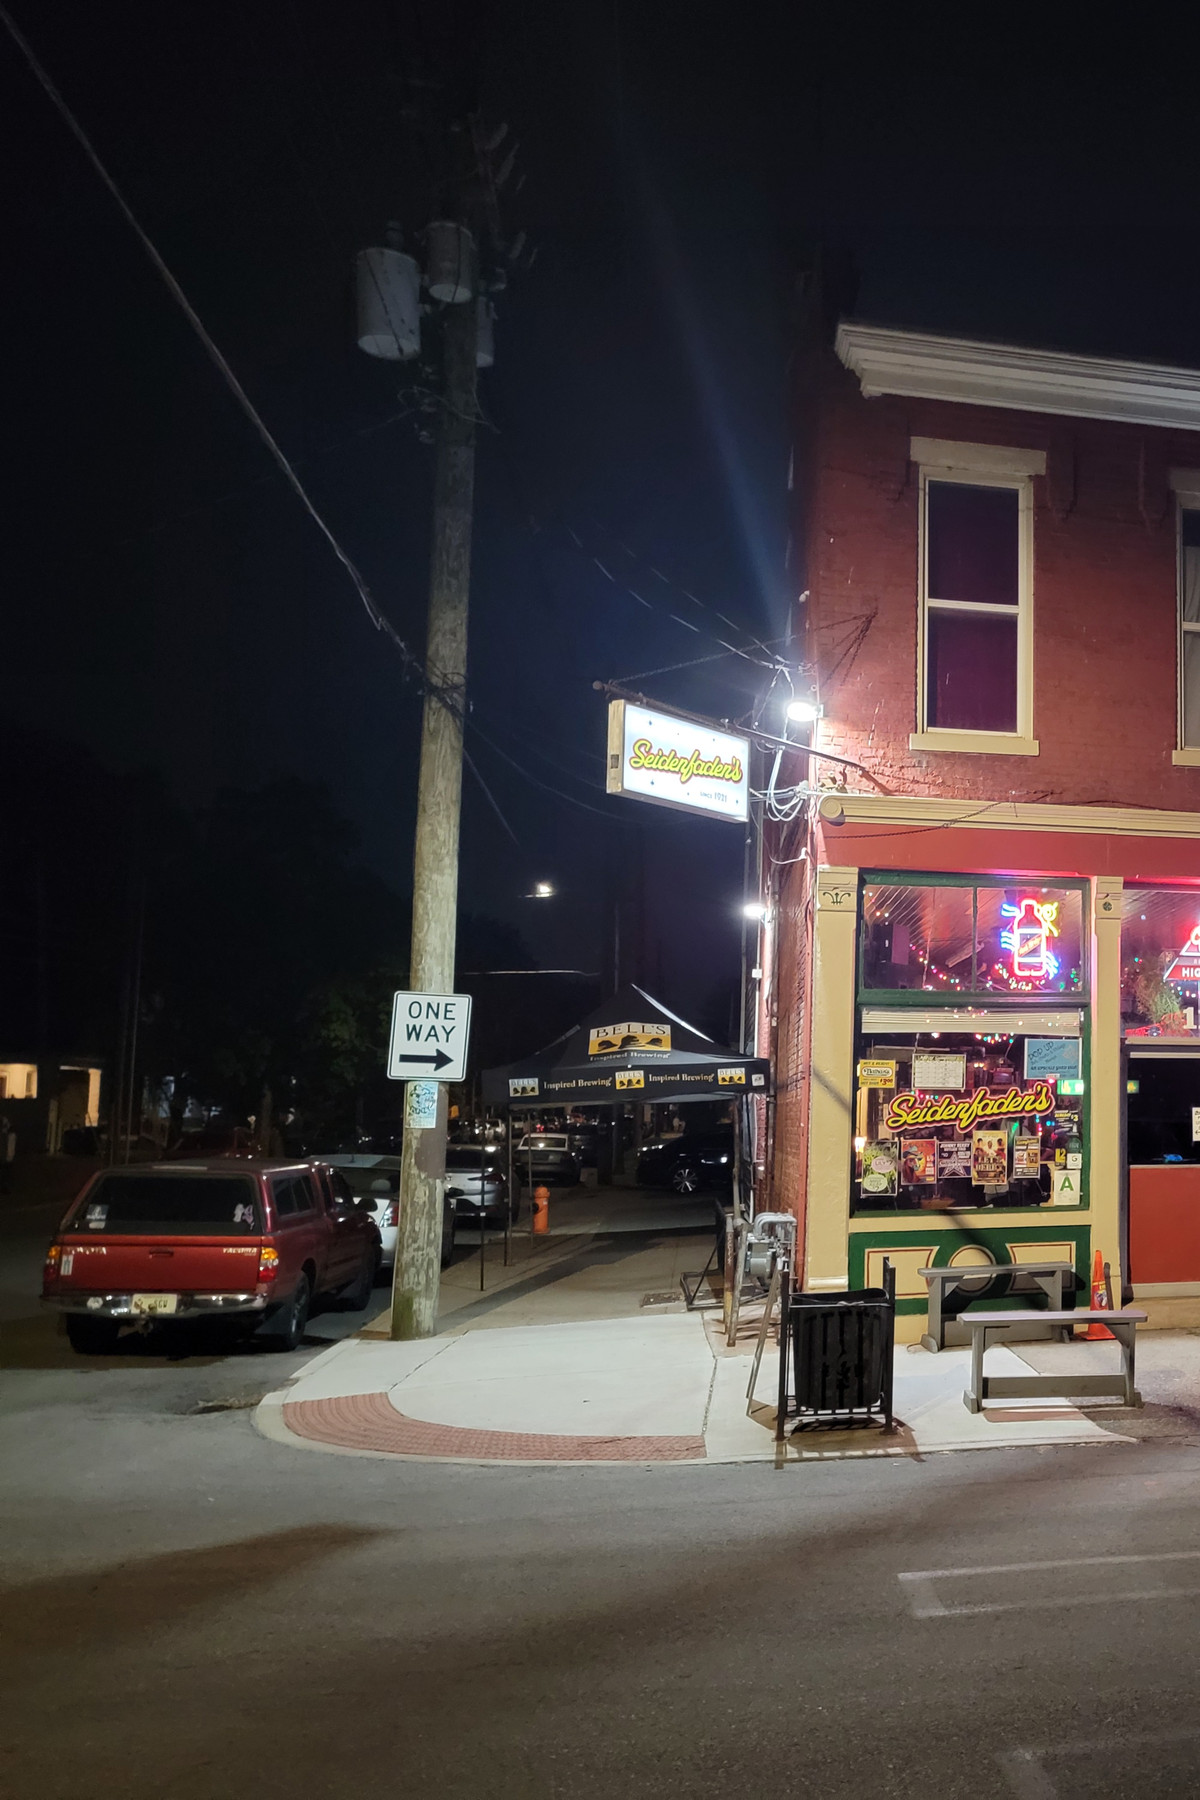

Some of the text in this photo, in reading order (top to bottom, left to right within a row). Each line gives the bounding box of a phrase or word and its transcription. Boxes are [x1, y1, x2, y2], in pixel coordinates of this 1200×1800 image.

[630, 738, 743, 784] Seidenfaden's
[408, 1001, 456, 1021] ONE
[406, 1024, 456, 1043] WAY
[596, 1023, 666, 1038] BELL'S
[630, 1051, 671, 1059] Brewing
[543, 1077, 612, 1091] Inspired Brewing
[649, 1073, 715, 1083] Inspired Brewing
[886, 1083, 1054, 1132] Seidenfaden's
[1060, 1176, 1074, 1191] A
